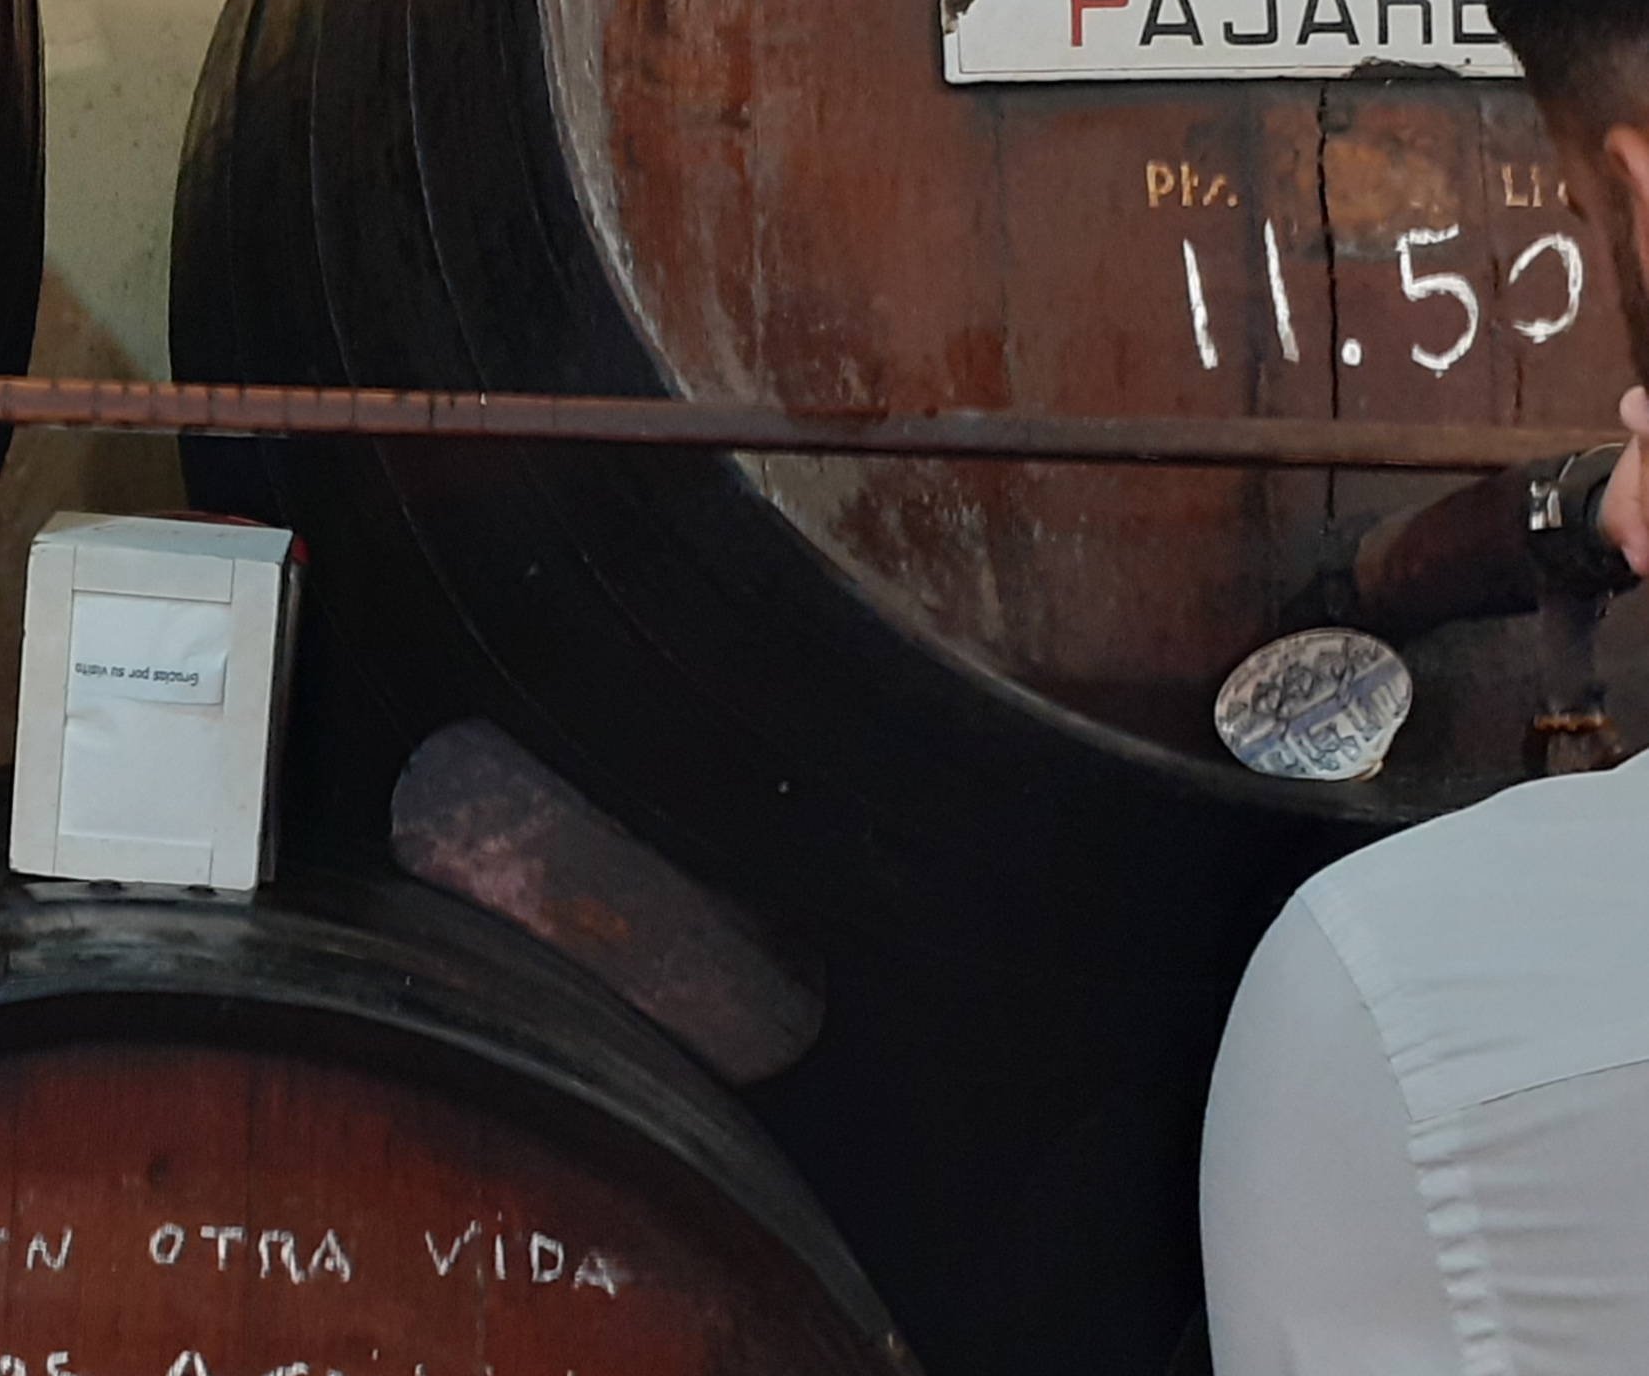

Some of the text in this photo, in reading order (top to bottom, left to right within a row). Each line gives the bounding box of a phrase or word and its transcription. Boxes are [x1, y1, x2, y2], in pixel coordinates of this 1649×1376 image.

[1183, 218, 1583, 378] 11.50
[111, 666, 125, 678] su
[128, 666, 150, 680] por
[153, 670, 199, 687] Gracias
[150, 1223, 352, 1284] OTRA
